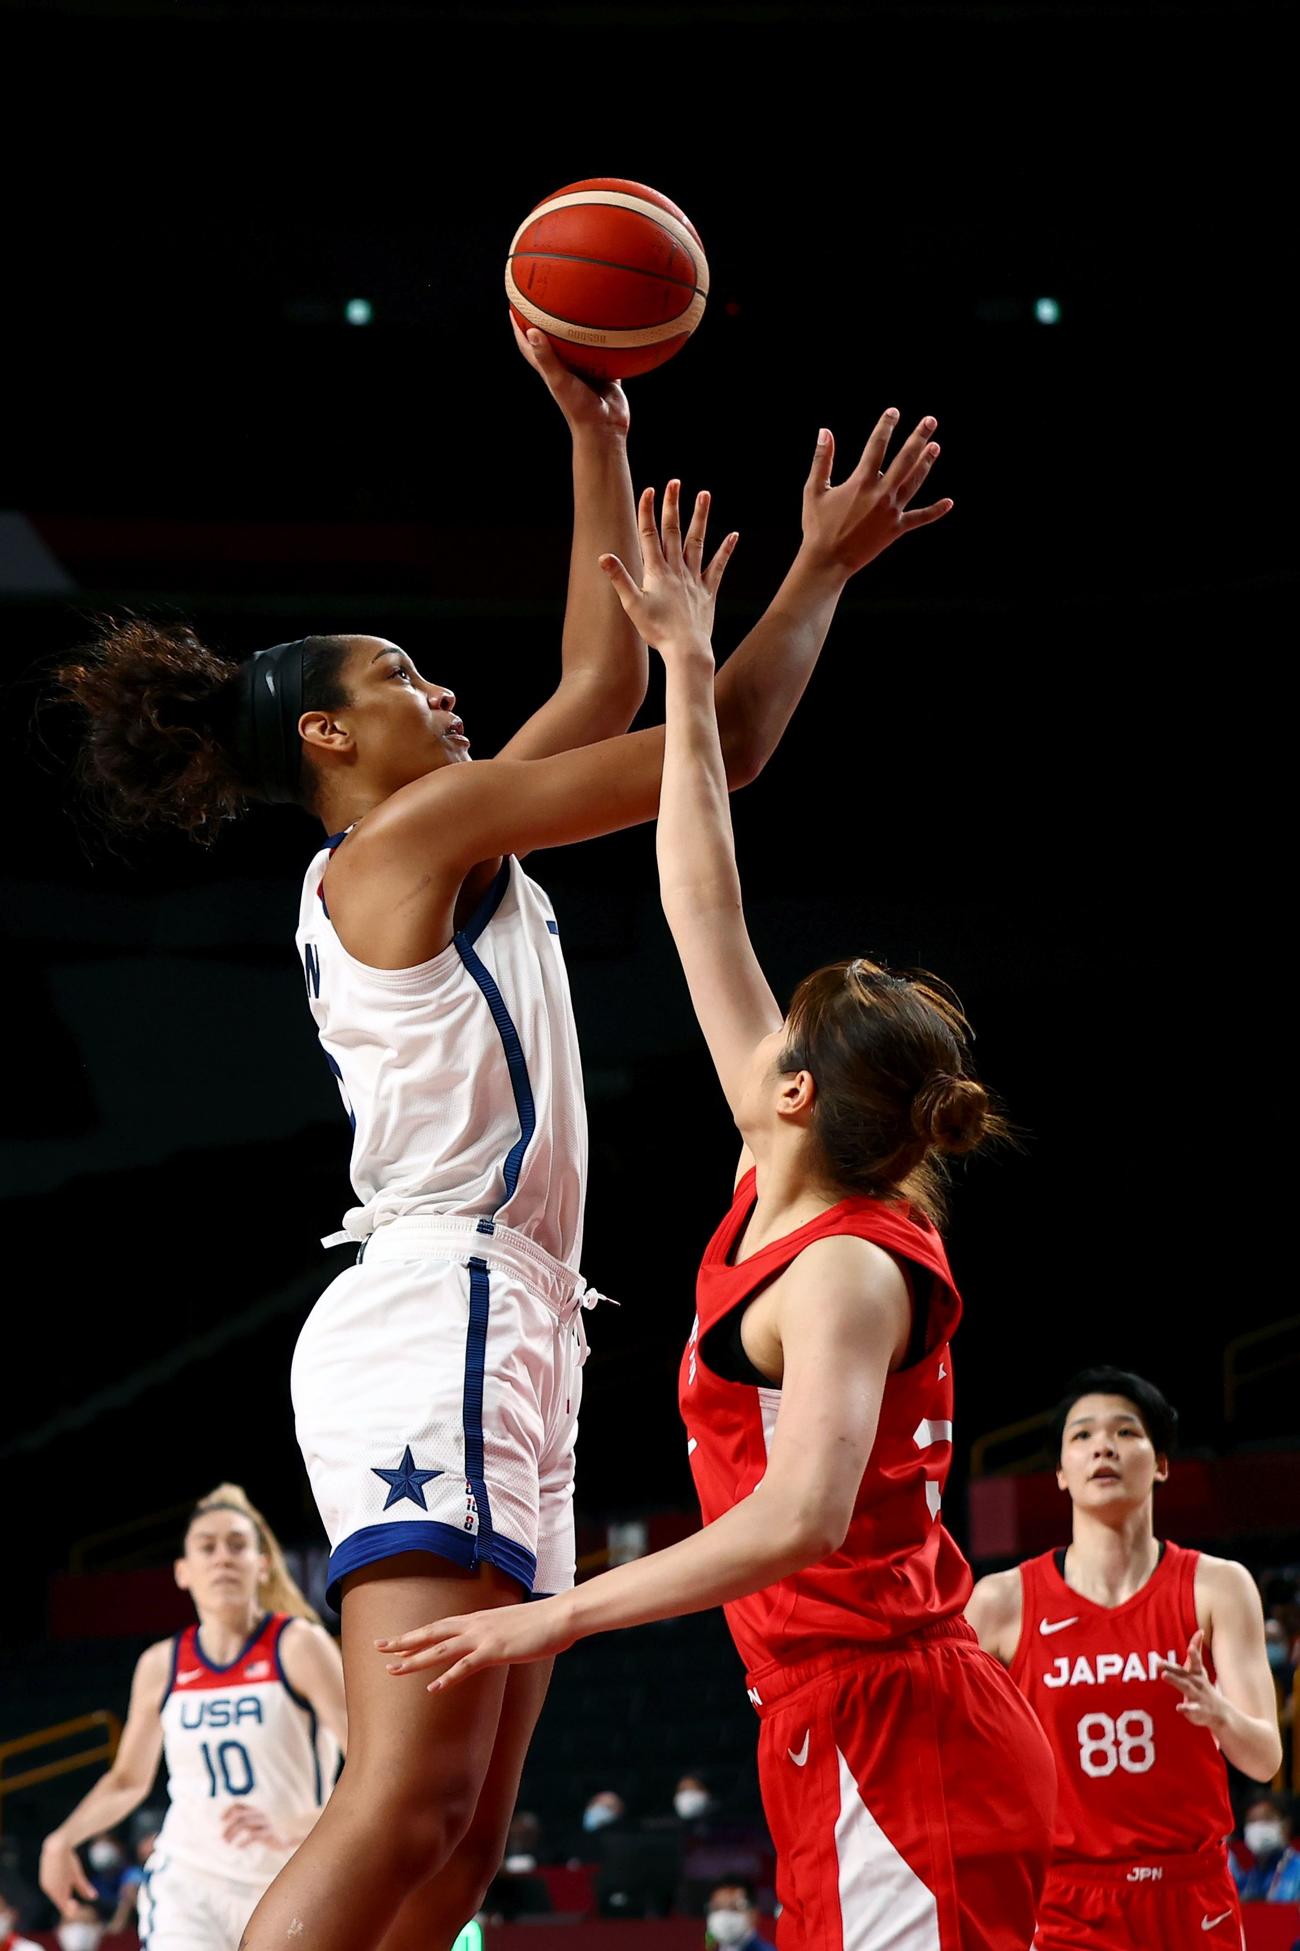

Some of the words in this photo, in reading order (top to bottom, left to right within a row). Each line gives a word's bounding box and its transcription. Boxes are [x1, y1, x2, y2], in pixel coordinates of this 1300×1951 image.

[1042, 1649, 1177, 1688] JAPAN
[179, 1696, 264, 1730] USA
[1076, 1708, 1156, 1778] 88
[199, 1739, 256, 1798] 10
[1126, 1866, 1163, 1882] JPN
